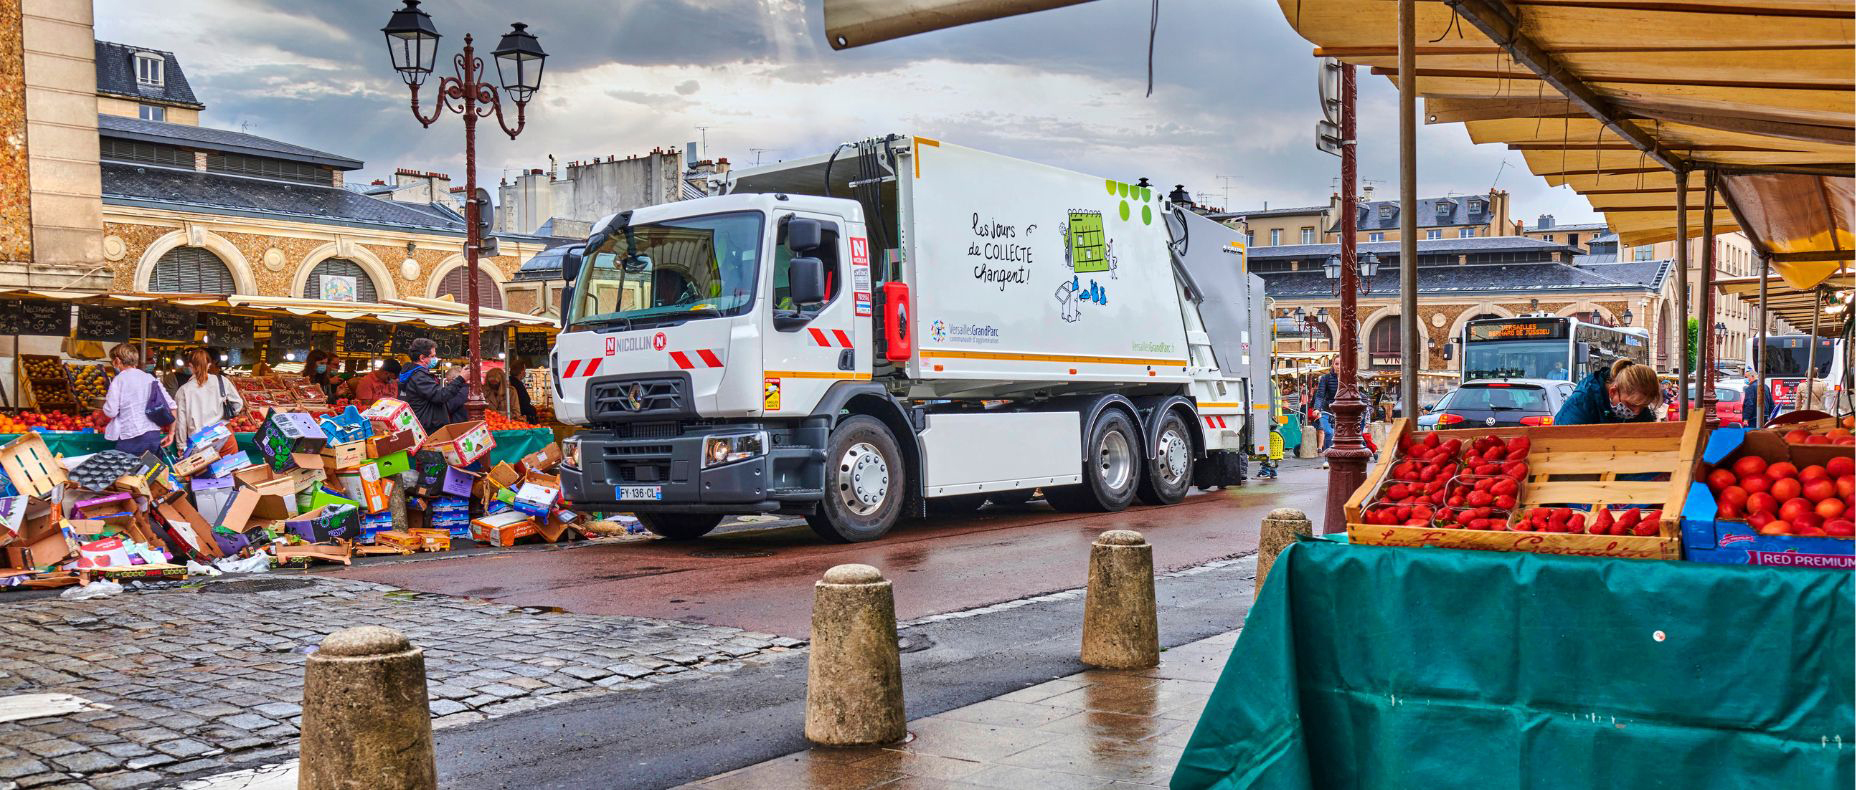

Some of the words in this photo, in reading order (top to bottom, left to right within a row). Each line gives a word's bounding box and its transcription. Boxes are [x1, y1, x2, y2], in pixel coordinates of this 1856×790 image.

[991, 217, 1016, 239] jours
[968, 241, 981, 256] de
[984, 243, 1033, 263] COLLECTE
[617, 336, 652, 353] NICOLLIN
[1763, 554, 1792, 565] RED
